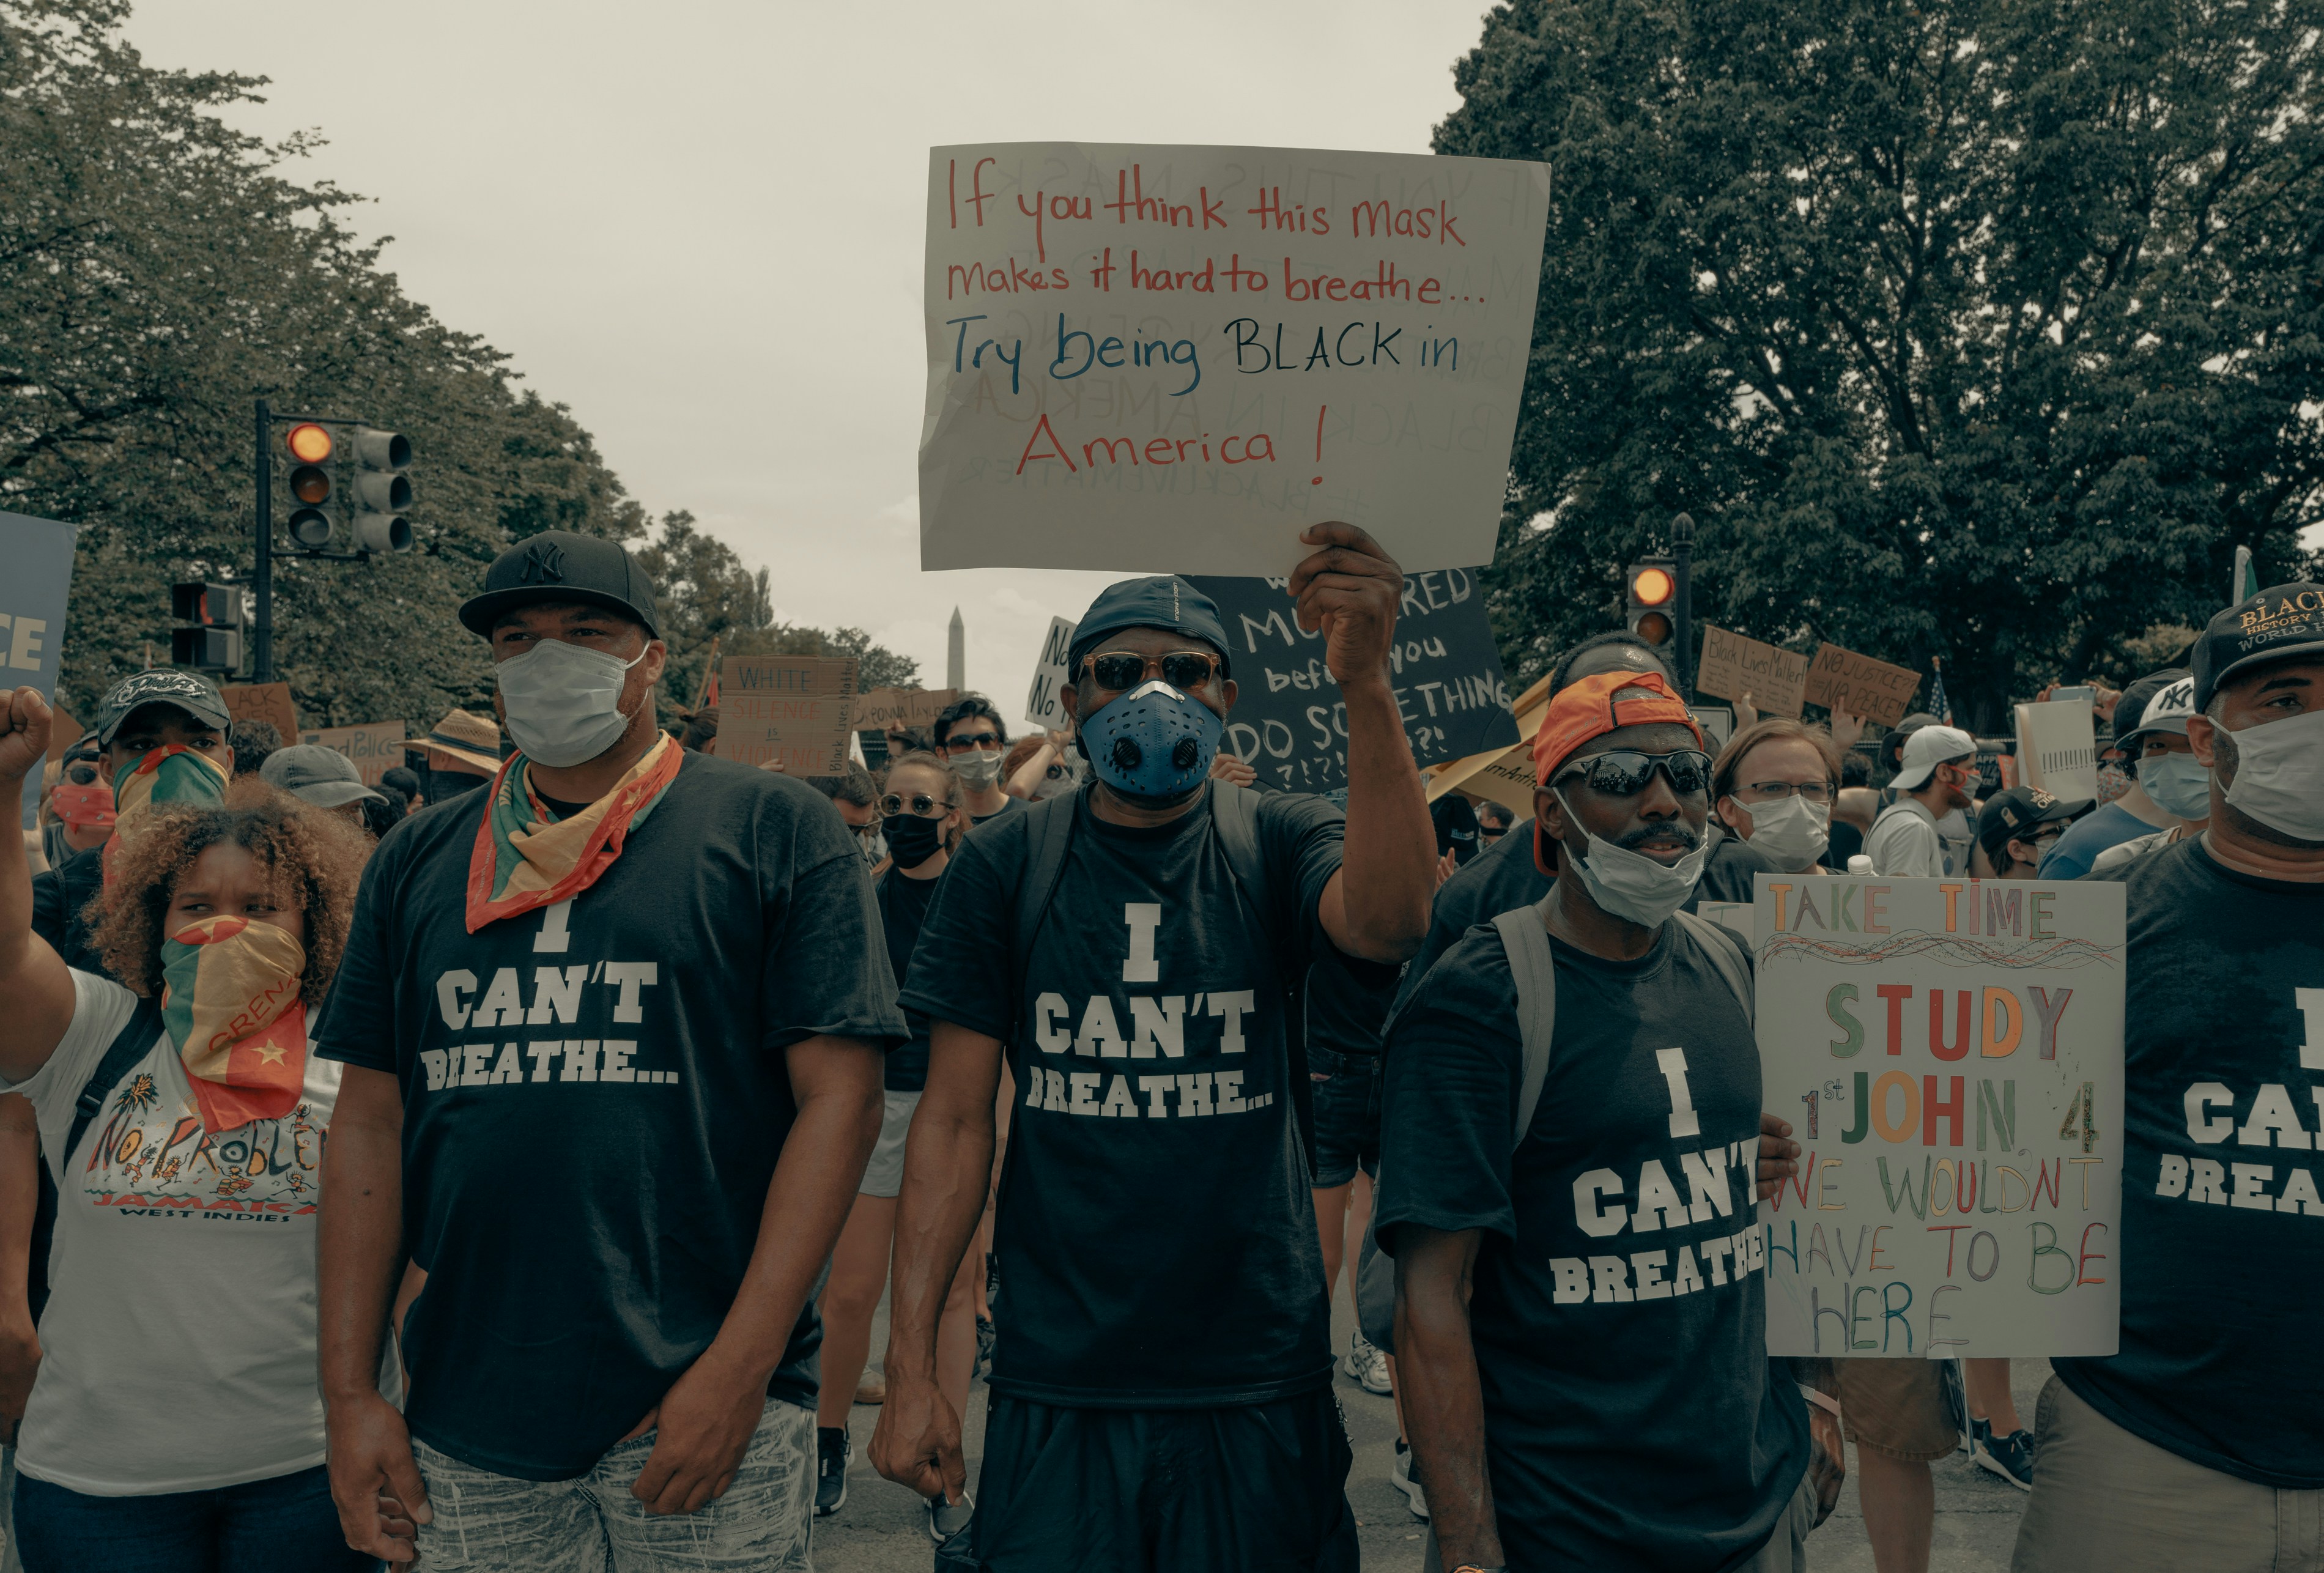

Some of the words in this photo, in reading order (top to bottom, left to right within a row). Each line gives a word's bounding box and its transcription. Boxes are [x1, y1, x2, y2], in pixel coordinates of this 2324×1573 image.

[950, 157, 996, 230] If
[1018, 190, 1092, 263] you
[1104, 163, 1228, 230] think
[1248, 186, 1330, 235] this
[1090, 247, 1118, 292] it
[1131, 249, 1215, 294] hard
[1220, 253, 1270, 293] to
[1284, 257, 1487, 305] breathe...
[946, 314, 1021, 394] Try
[1049, 312, 1202, 396] being
[1223, 317, 1403, 376] BLACK
[1421, 325, 1459, 371] in
[1016, 413, 1277, 475] America
[520, 541, 565, 583] NY
[2238, 625, 2308, 652] WORLD
[2246, 613, 2312, 635] HISTORY
[1708, 629, 1737, 665] Black
[1741, 640, 1769, 675] Lives
[1817, 650, 1845, 673] NO
[738, 666, 812, 692] WHITE
[838, 660, 854, 700] Matter
[1029, 673, 1055, 717] No
[1819, 678, 1849, 705] NO
[2158, 684, 2193, 710] NY
[731, 697, 822, 720] SILENCE
[834, 704, 849, 732] Lives
[1227, 717, 1294, 765] DO
[1306, 668, 1514, 751] SOETHING
[352, 731, 401, 758] Police
[731, 743, 826, 770] VIOLENCE
[829, 738, 844, 772] Black
[1767, 882, 1892, 935] TAKE
[1938, 877, 2057, 941] TIME
[1122, 902, 1161, 982] I
[436, 960, 658, 1030] CAN'T
[1825, 981, 2074, 1062] STUDY
[1035, 989, 1256, 1059] CAN'T
[419, 1039, 679, 1092] BREATHE...
[1026, 1064, 1273, 1118] BREATHE...
[1654, 1046, 1701, 1138] I
[1840, 1068, 2016, 1152] JOHN
[2059, 1080, 2101, 1155] 4
[2183, 1081, 2324, 1150] CA
[93, 1193, 318, 1215] JAMAICA
[1572, 1134, 1761, 1237] CAN'T
[119, 1207, 195, 1219] WEST
[202, 1211, 290, 1223] INDIES
[1548, 1222, 1764, 1305] BREATHE
[1766, 1220, 1896, 1279] HAVE
[1926, 1224, 2000, 1282] TO
[2027, 1221, 2108, 1295] BE
[1812, 1280, 1971, 1353] HERE
